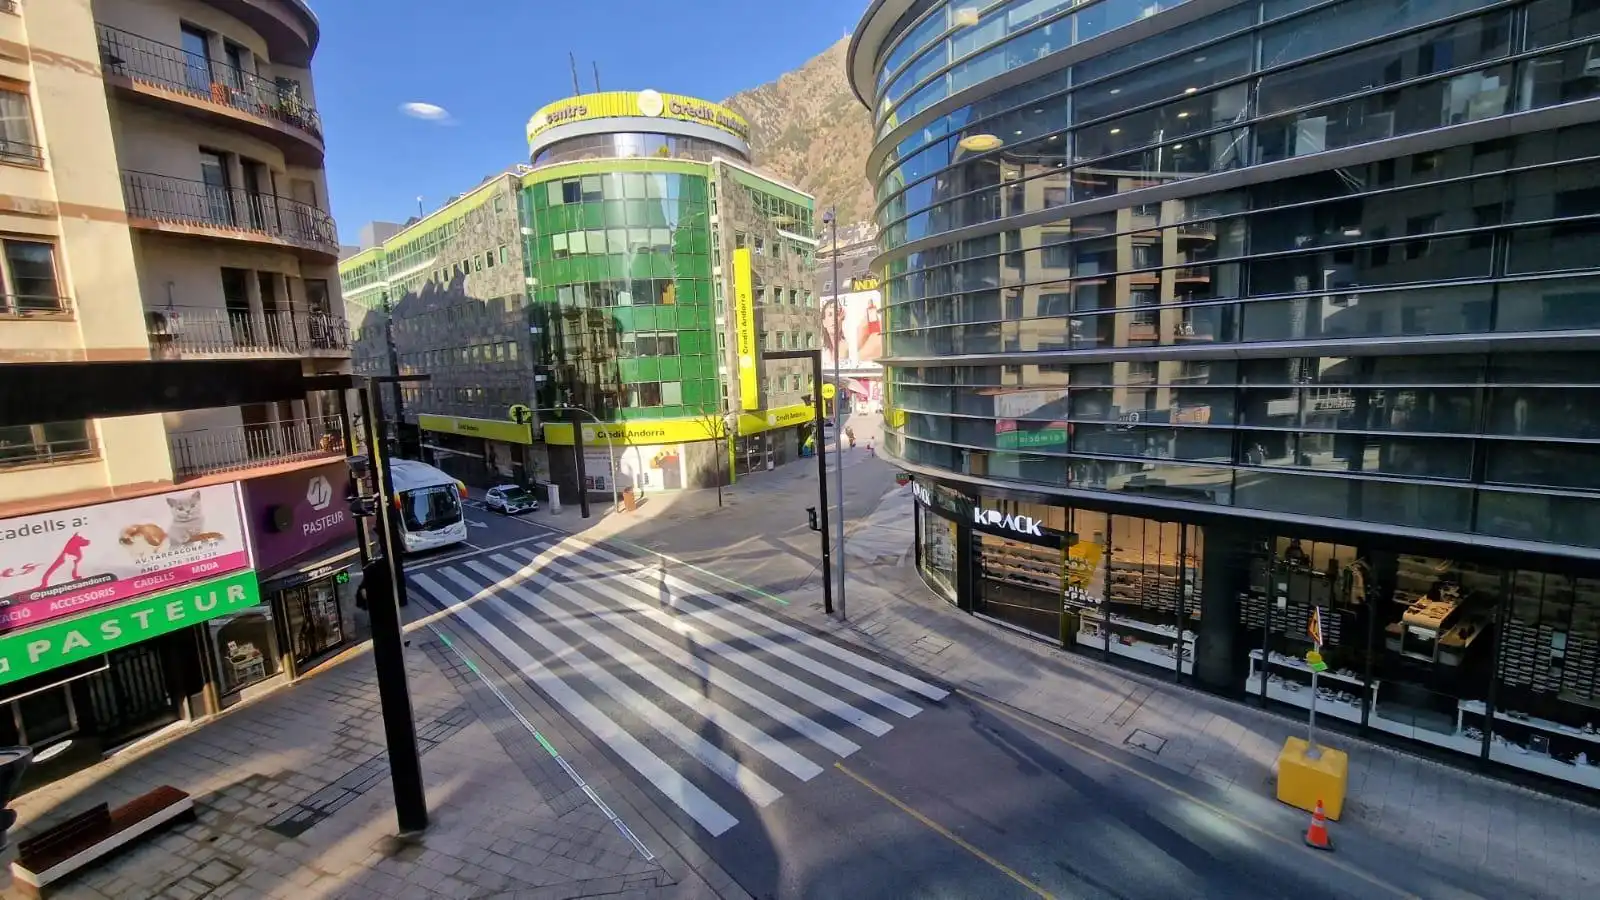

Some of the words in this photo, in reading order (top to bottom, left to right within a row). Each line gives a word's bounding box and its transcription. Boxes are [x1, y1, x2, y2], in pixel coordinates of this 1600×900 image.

[302, 510, 344, 537] PASTEUR
[974, 507, 1042, 536] KRACK
[191, 561, 219, 574] MODA
[133, 572, 175, 589] CADELLS
[50, 587, 116, 611] ACCESSORIS
[26, 584, 247, 664] PASTEUR
